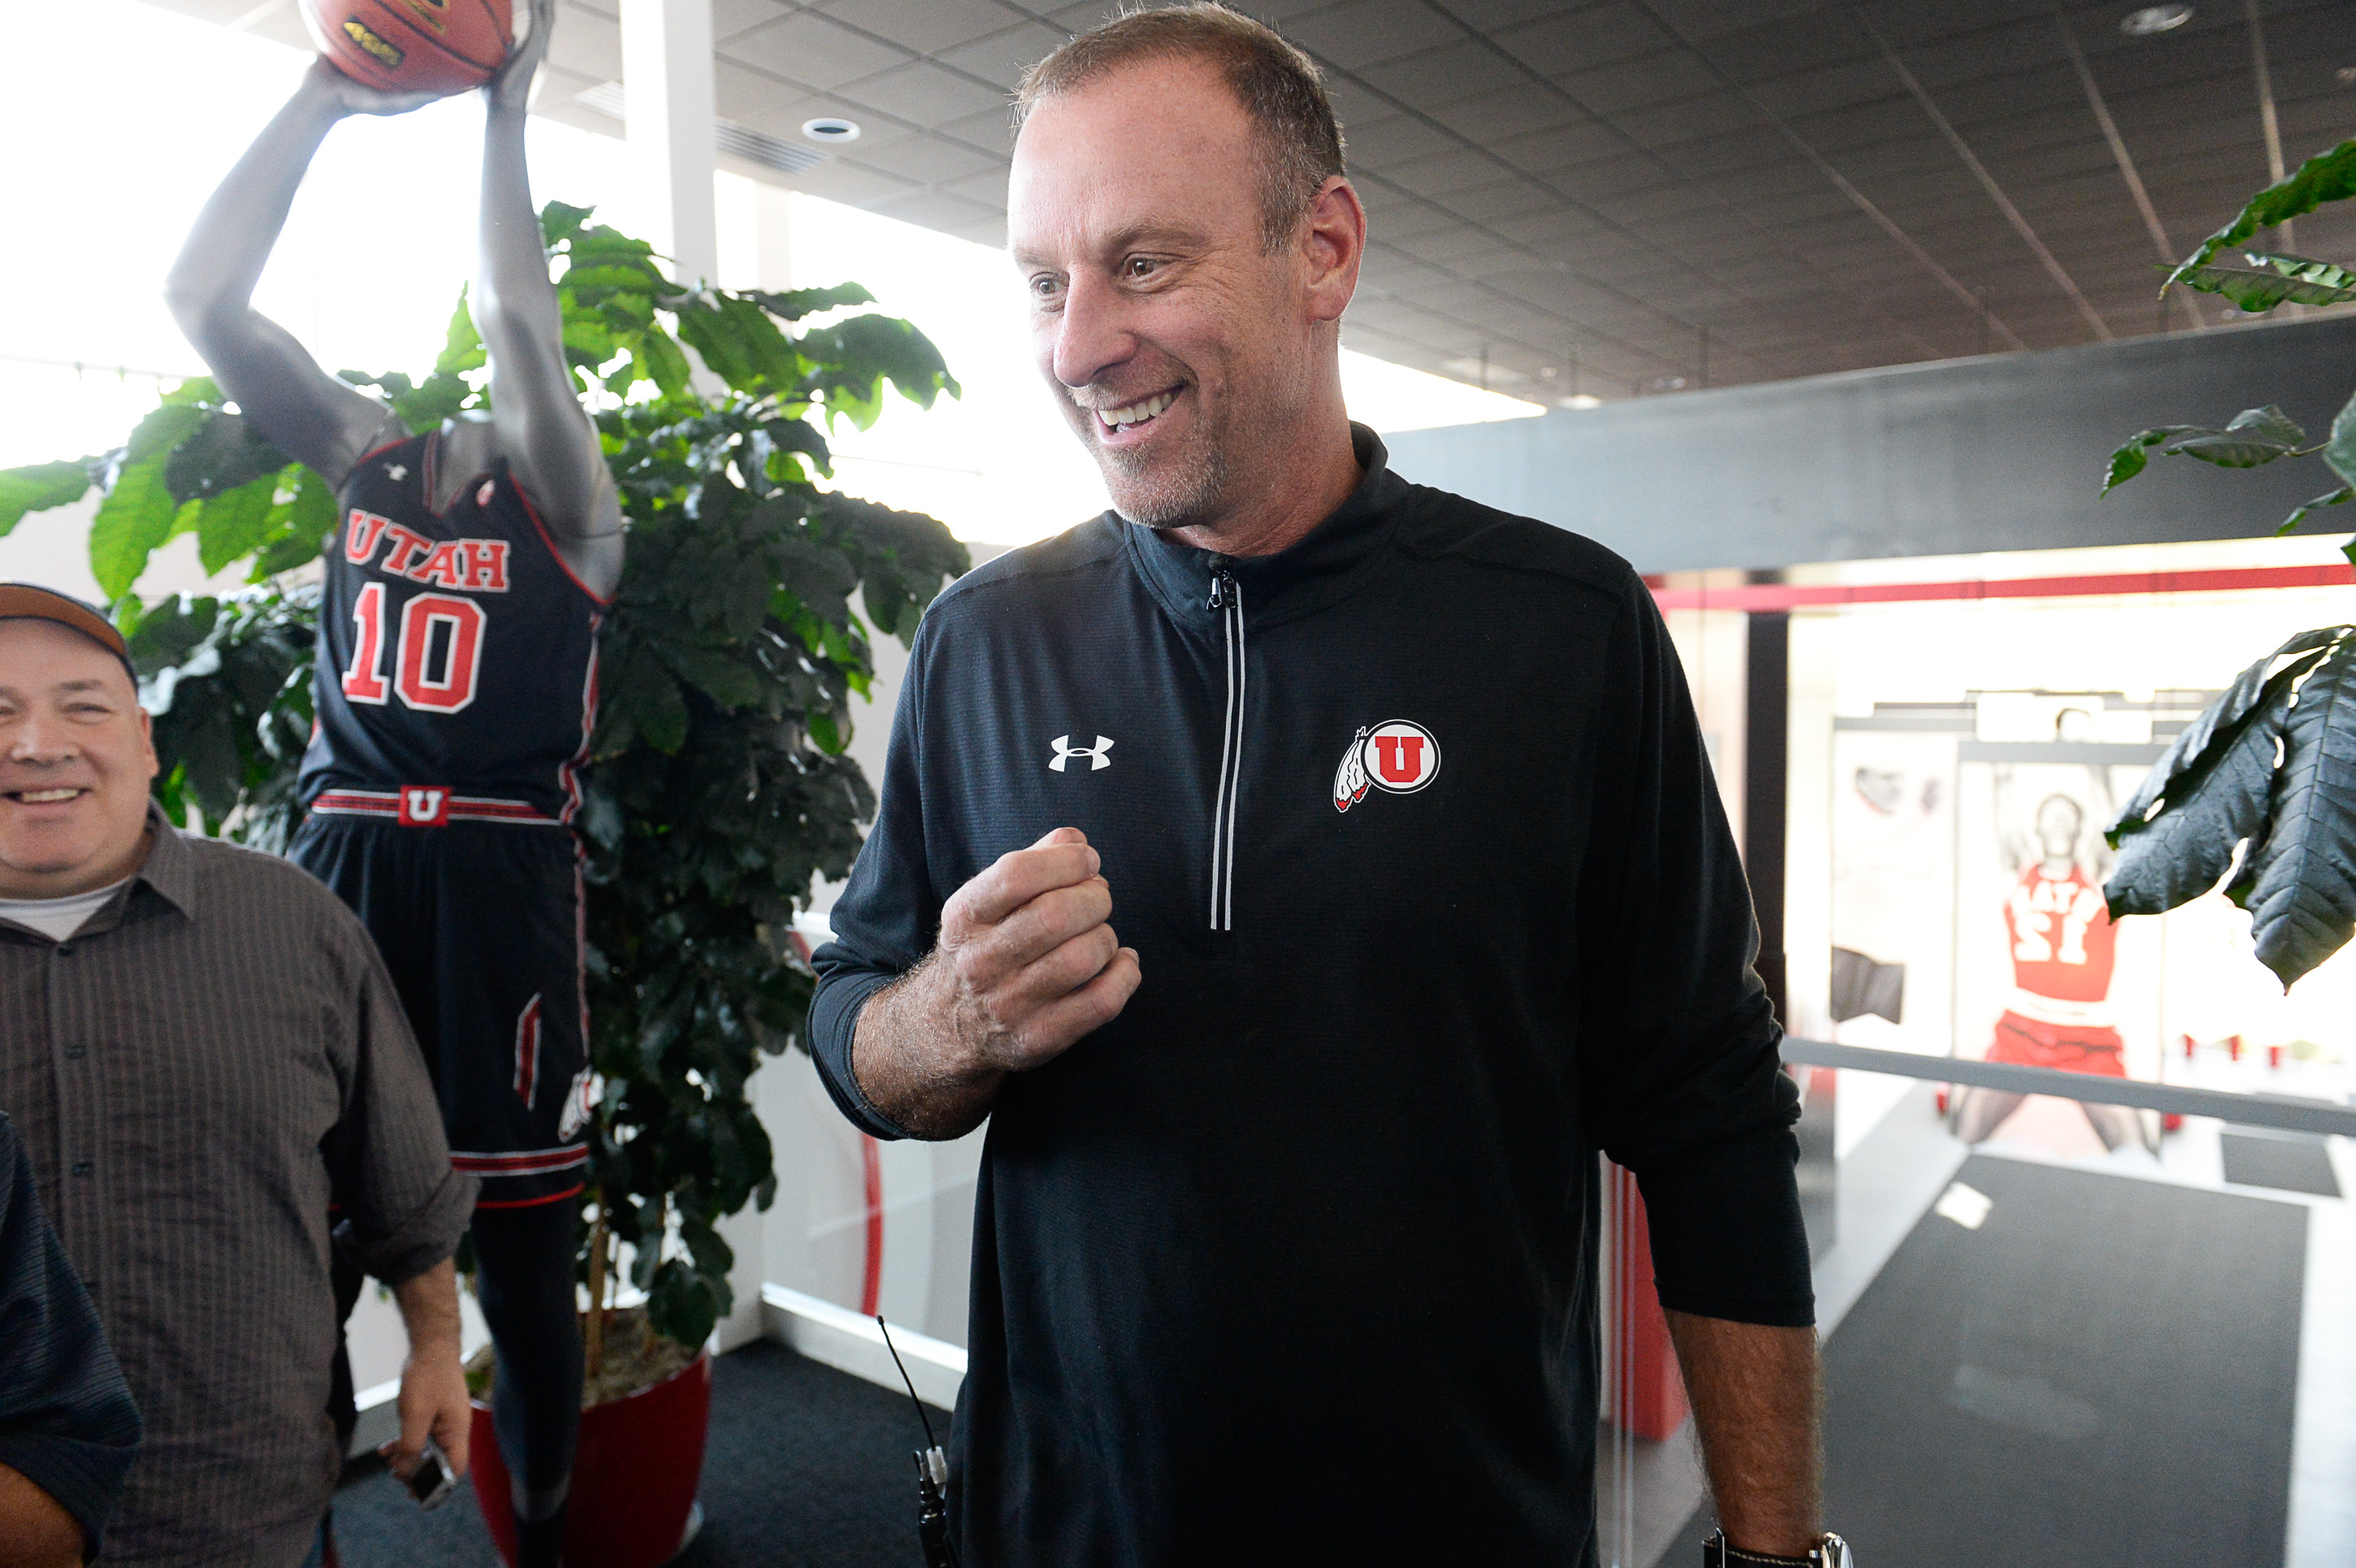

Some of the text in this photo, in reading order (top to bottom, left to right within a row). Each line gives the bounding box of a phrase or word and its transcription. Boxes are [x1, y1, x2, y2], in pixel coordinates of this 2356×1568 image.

[344, 508, 510, 592] UTAH
[341, 581, 487, 715] 10
[1375, 735, 1424, 783] U
[408, 790, 444, 821] U
